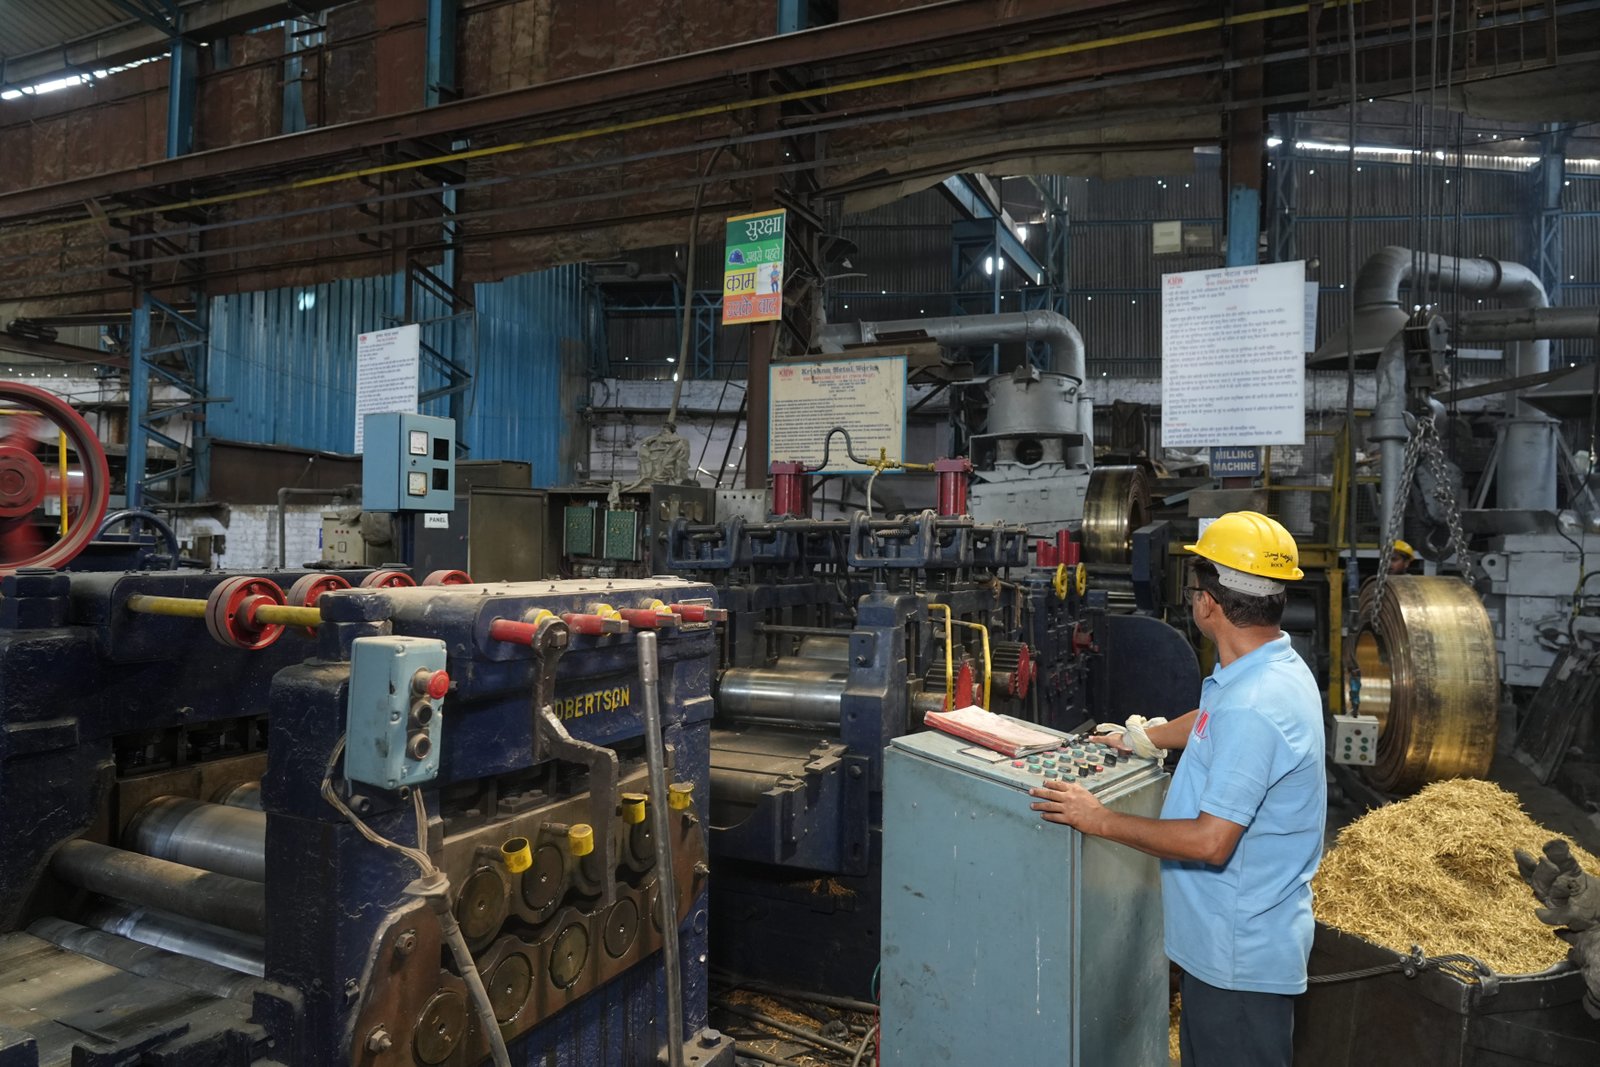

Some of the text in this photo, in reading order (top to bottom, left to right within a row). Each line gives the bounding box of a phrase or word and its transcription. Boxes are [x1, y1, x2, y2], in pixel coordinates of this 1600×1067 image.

[745, 216, 782, 241] सुरक्षा
[746, 244, 780, 263] सबसे पहले
[726, 271, 756, 292] काम
[728, 296, 777, 317] उसके बाद
[1215, 450, 1254, 459] MILLING
[1213, 462, 1257, 471] MACHINE
[554, 686, 631, 721] OBERTSON
